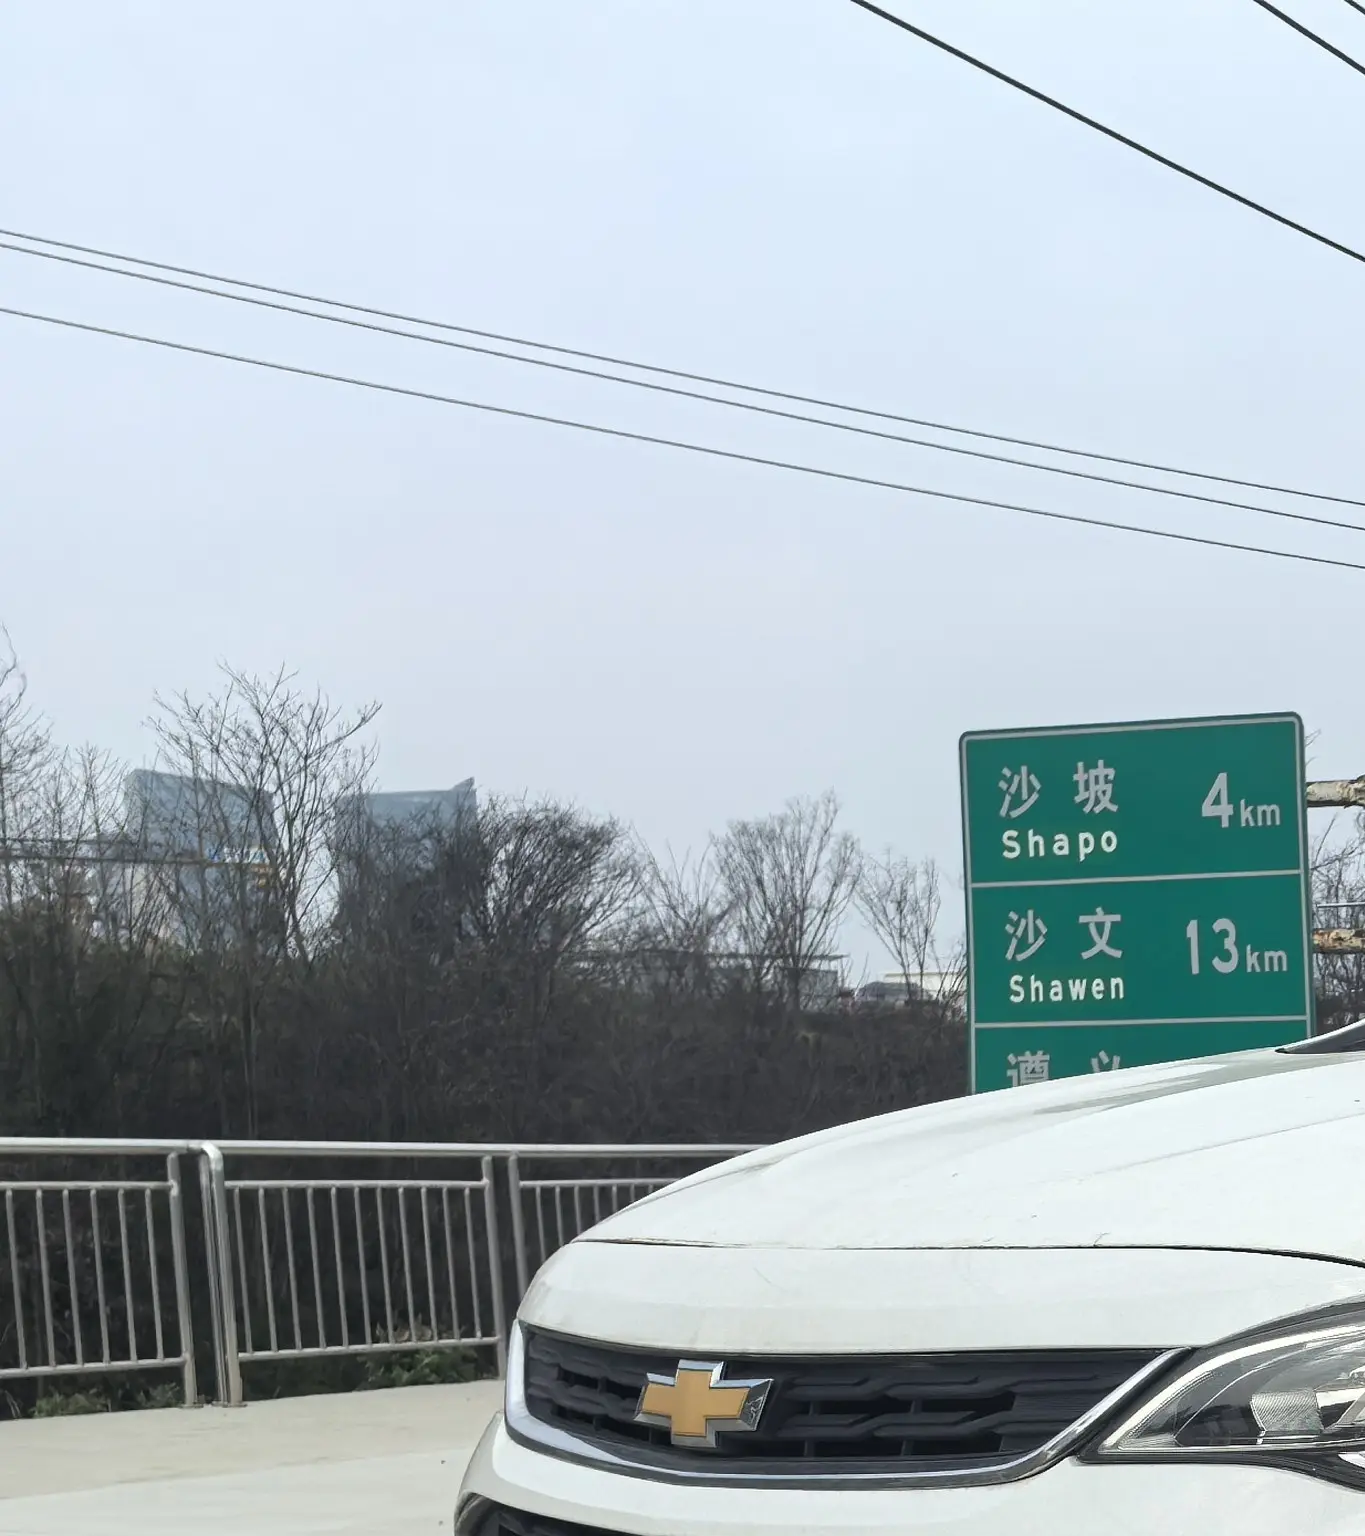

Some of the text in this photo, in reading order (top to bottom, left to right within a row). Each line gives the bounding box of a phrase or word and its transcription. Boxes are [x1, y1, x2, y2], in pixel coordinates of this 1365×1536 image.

[998, 759, 1118, 818] 沙坡
[1002, 829, 1118, 861] Shapo
[1004, 906, 1122, 961] 沙文
[1009, 975, 1125, 1003] Shawen
